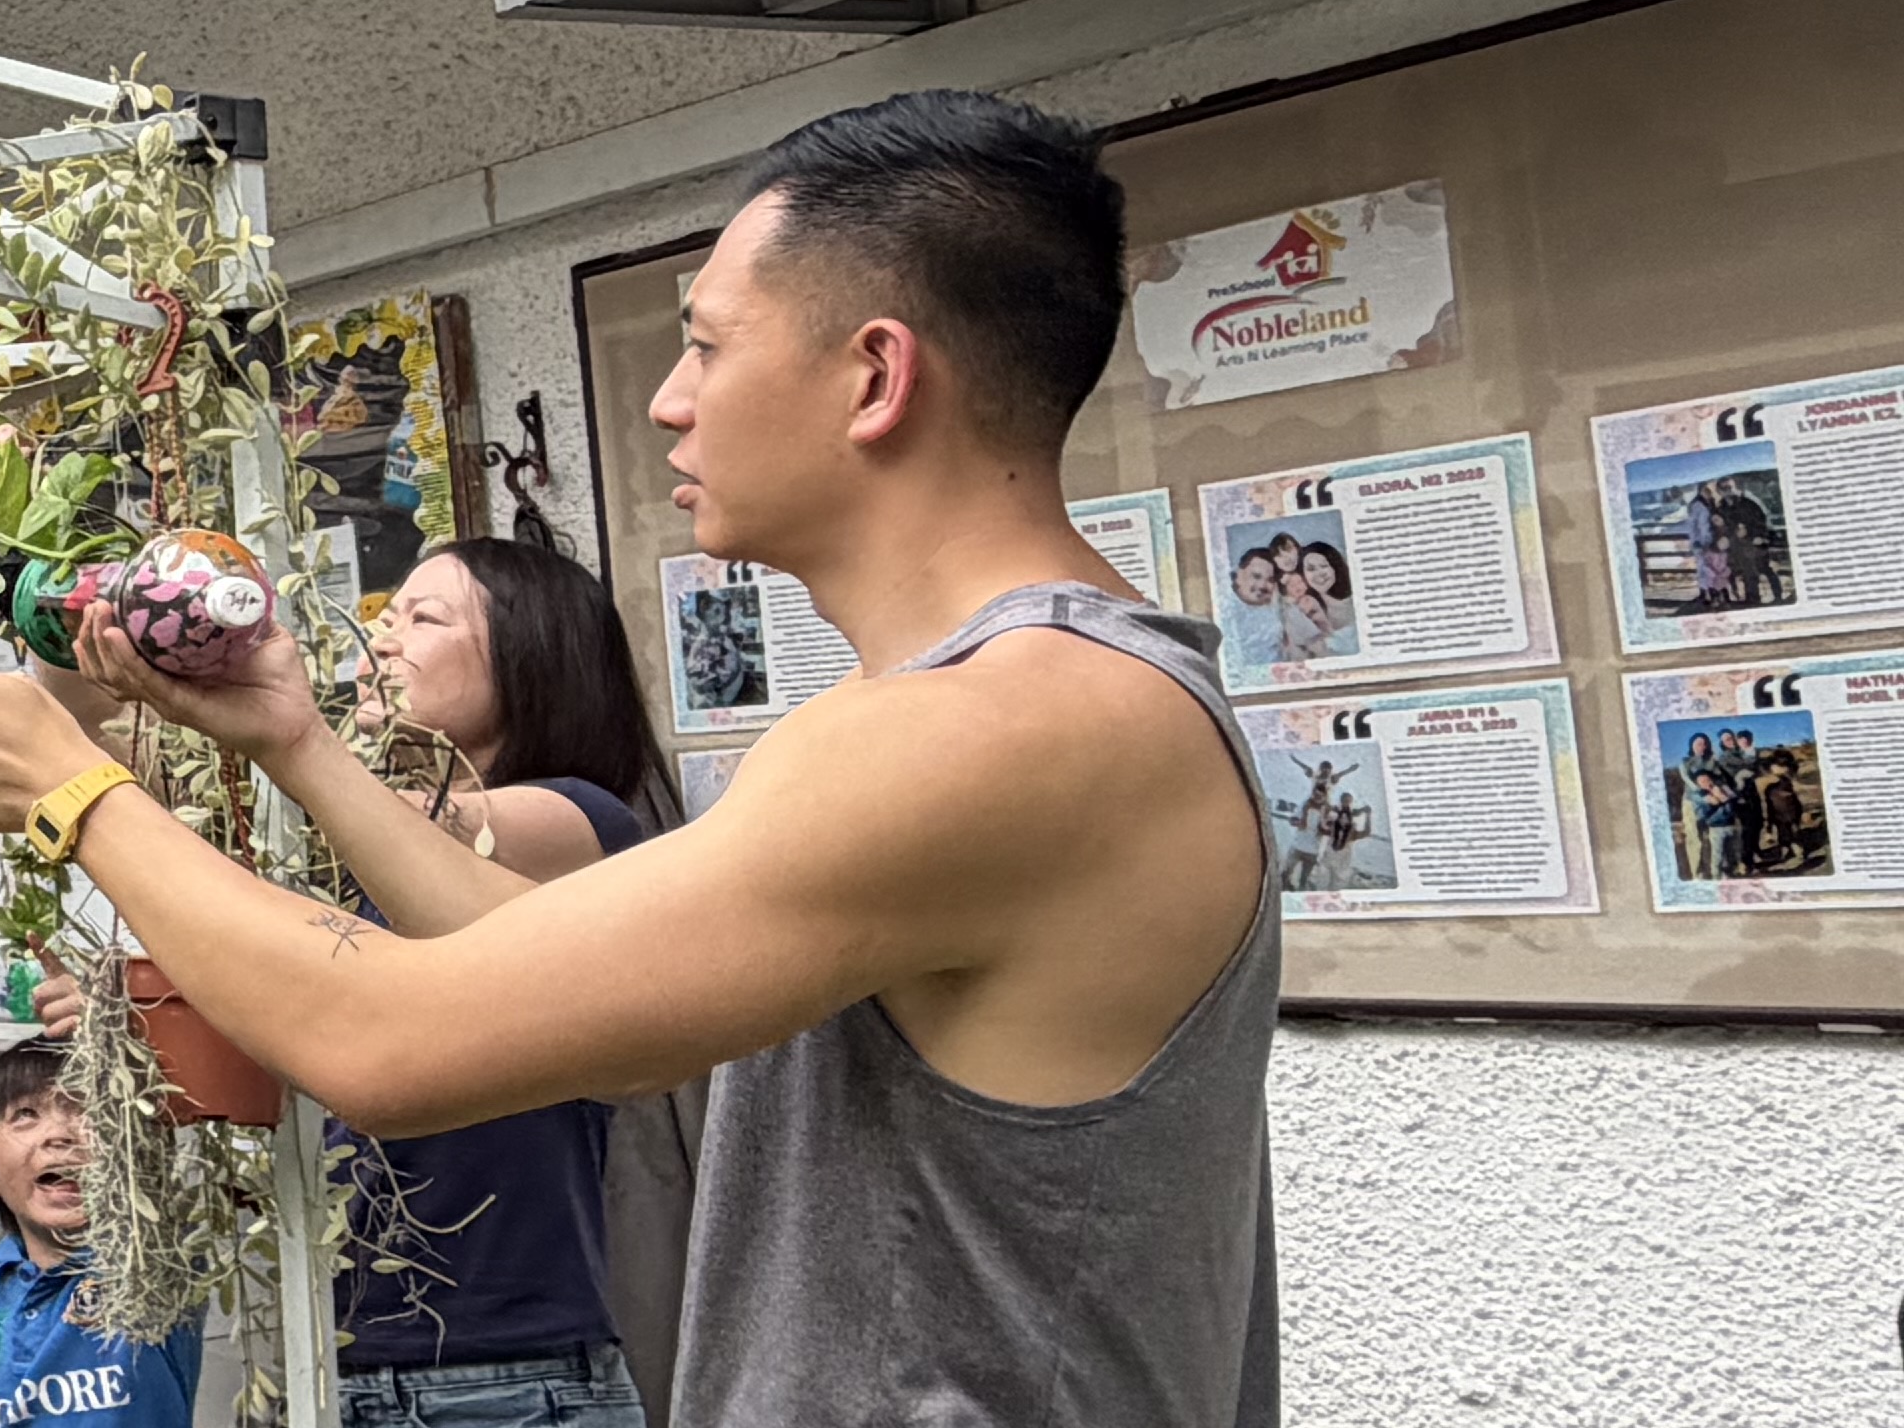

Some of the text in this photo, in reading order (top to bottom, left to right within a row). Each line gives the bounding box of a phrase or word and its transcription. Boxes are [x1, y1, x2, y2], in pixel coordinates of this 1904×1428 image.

[1211, 296, 1371, 353] Nobleland
[1262, 337, 1326, 362] Learning
[1329, 330, 1369, 349] Place
